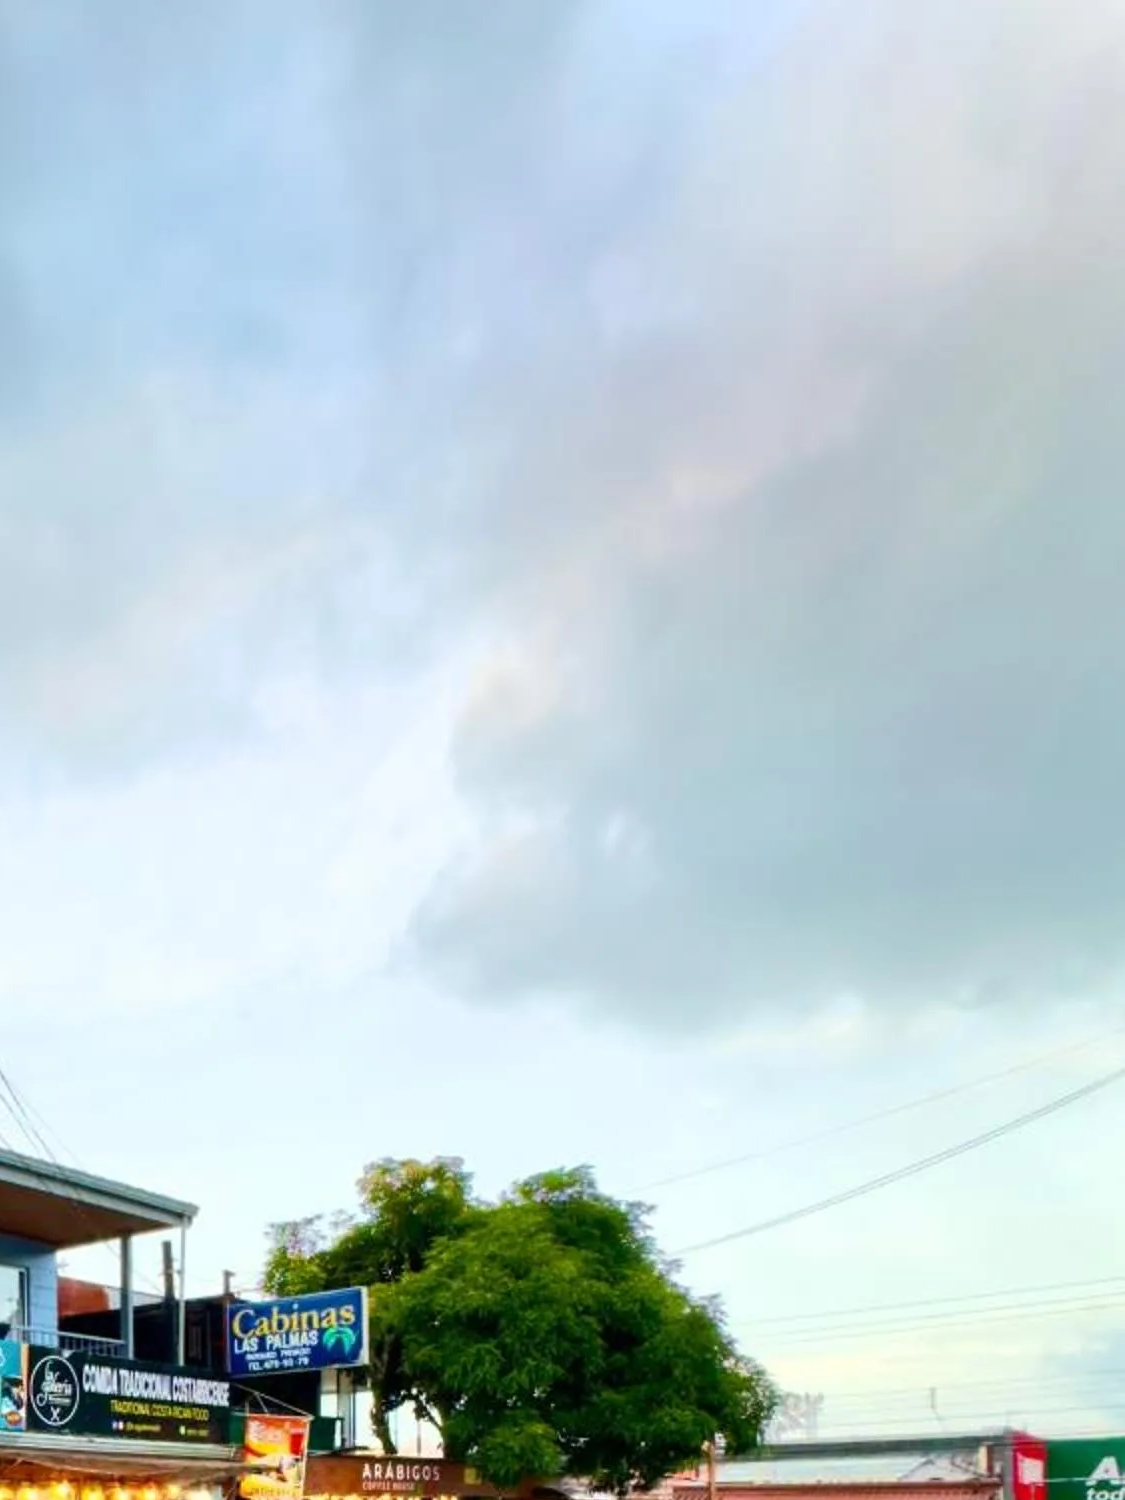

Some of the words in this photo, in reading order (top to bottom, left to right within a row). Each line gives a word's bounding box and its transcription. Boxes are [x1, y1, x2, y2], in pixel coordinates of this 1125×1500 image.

[232, 1303, 356, 1339] Cabinas
[233, 1336, 259, 1355] LAS
[265, 1329, 319, 1351] PALMAS
[82, 1364, 118, 1395] COMIDA
[362, 1461, 440, 1481] ARÁBIGOS
